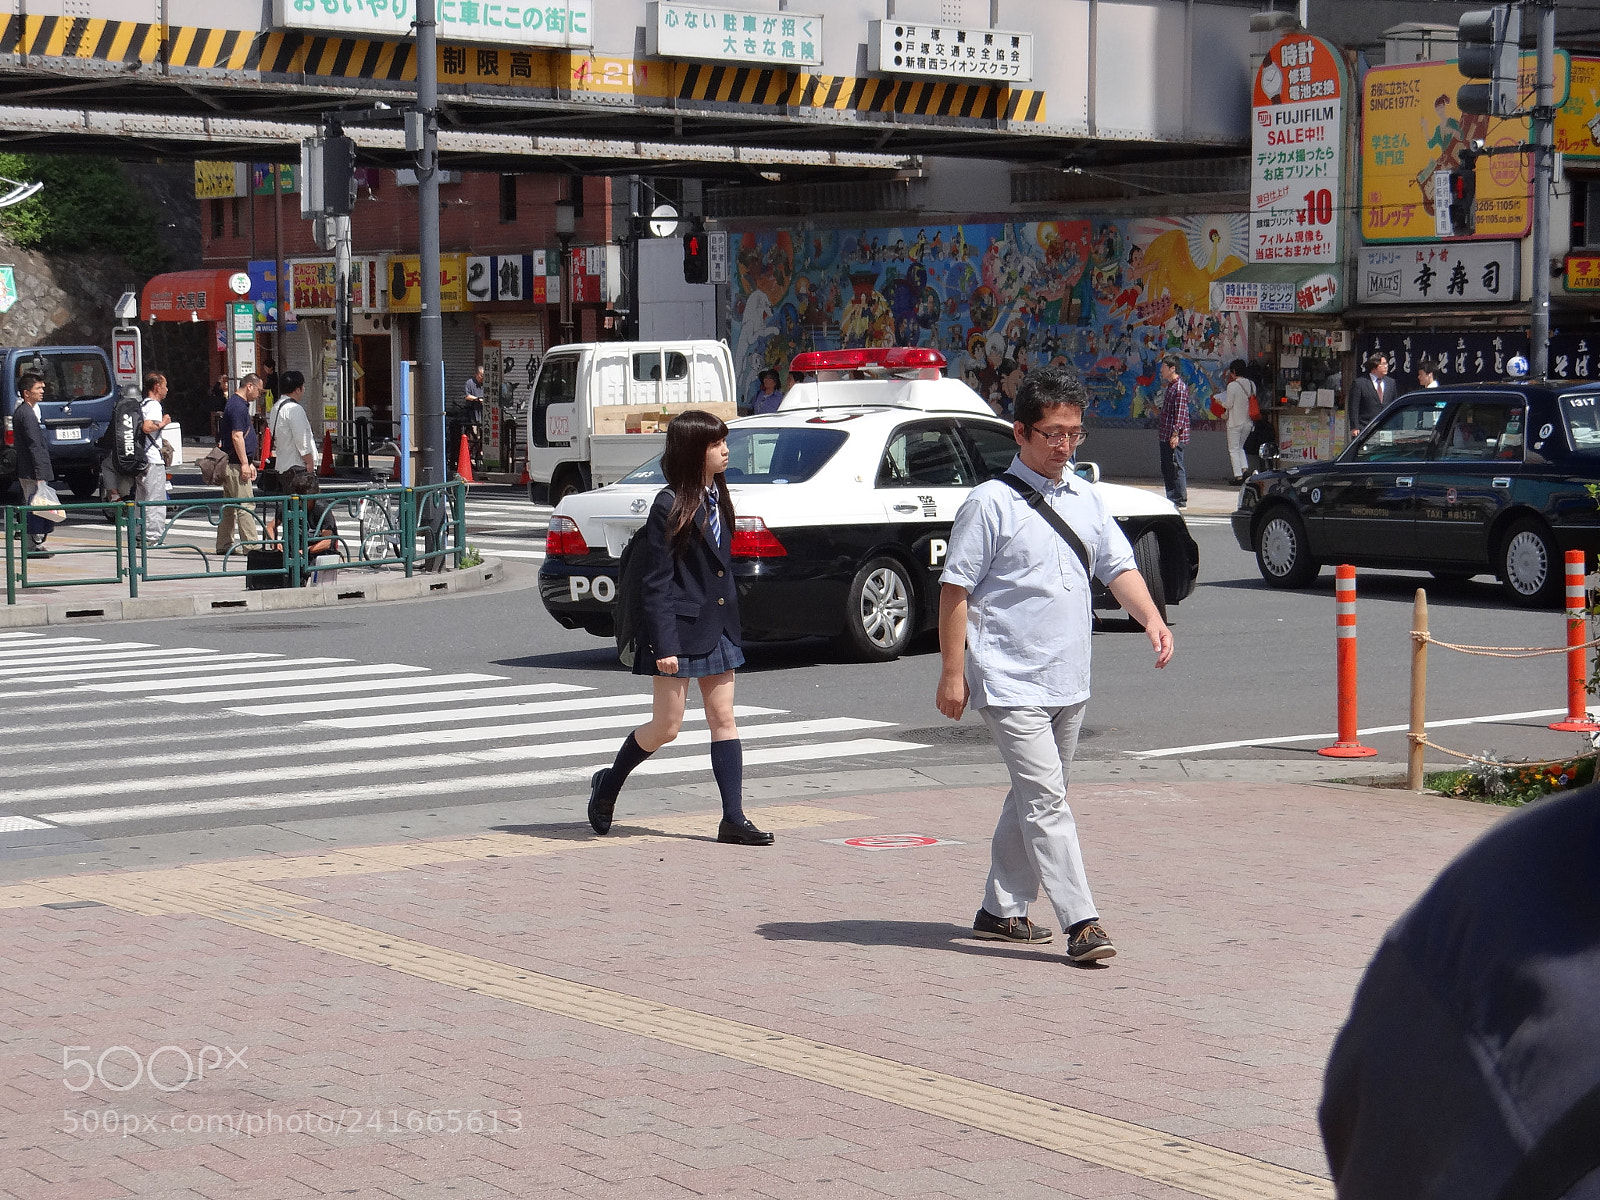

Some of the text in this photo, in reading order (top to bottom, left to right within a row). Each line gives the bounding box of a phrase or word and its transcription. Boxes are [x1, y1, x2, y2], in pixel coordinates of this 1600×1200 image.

[294, 0, 588, 33] おもいやりに車にこの街に
[664, 10, 814, 37] 心ない駐車が招く
[906, 26, 1020, 47] 戸塚警察署
[723, 36, 815, 60] 大きな危険
[905, 41, 1020, 62] 戸塚交通安全協会
[1281, 40, 1315, 67] 時計
[443, 47, 648, 88] 制限高 4.2M
[905, 56, 1020, 76] 新宿西ライオンズクラブ
[1288, 66, 1311, 84] 修理
[1288, 79, 1335, 101] 電池交換
[1370, 79, 1421, 96] お役に立ちたくて
[1275, 106, 1334, 125] FUJIFILM
[1371, 132, 1410, 148] 学生さん
[1256, 146, 1335, 166] デジカメ撮ったら
[1374, 150, 1405, 166] 専門店
[1296, 188, 1333, 227] ¥10
[1258, 229, 1324, 246] フィルム現像も
[1415, 248, 1449, 264] 江戸前
[294, 265, 317, 276] とんこつ
[1413, 260, 1501, 297] 幸寿司
[294, 276, 317, 287] らーめん
[1226, 284, 1246, 295] 時計
[176, 291, 207, 310] 大黒屋
[1260, 292, 1293, 303] ダビング
[262, 324, 278, 333] WILLC
[1569, 397, 1596, 408] 1317
[123, 429, 135, 456] YONEX
[1426, 508, 1444, 519] TAXI
[929, 538, 948, 566] P
[569, 575, 616, 603] PO
